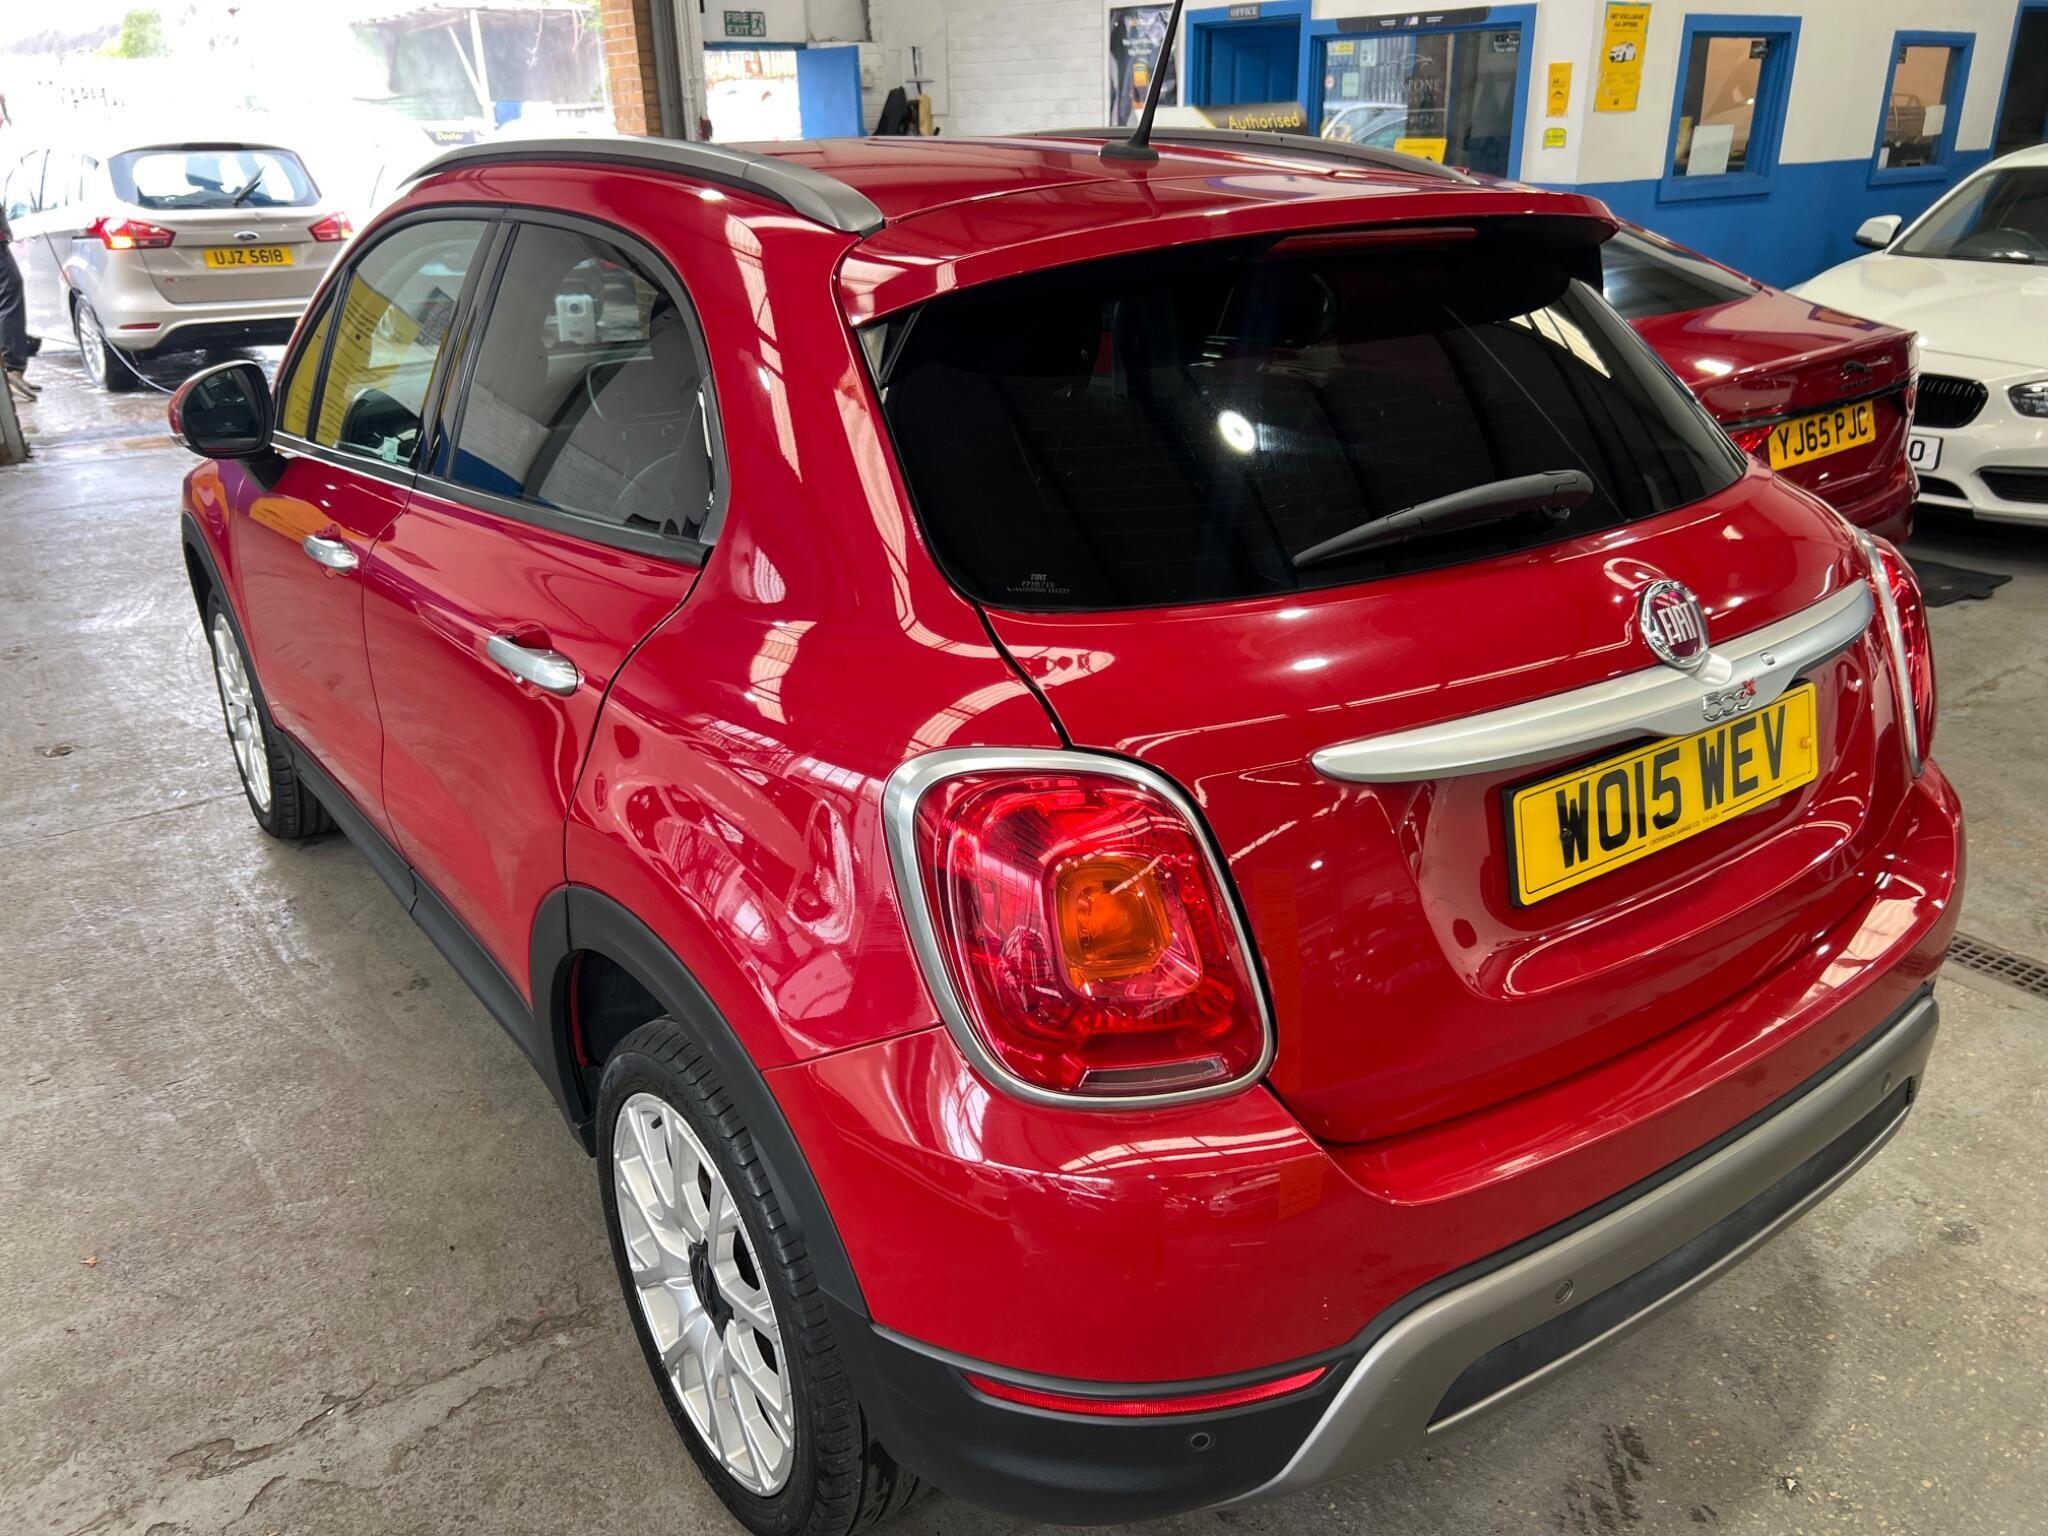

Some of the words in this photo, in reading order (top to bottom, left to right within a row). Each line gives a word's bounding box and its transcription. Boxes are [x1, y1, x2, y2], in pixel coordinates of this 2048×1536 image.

[727, 13, 750, 23] FIRE
[1230, 6, 1258, 17] OFFICE
[727, 25, 750, 35] EXIT
[1228, 111, 1300, 130] Authorised
[213, 250, 246, 265] UJZ
[249, 249, 284, 263] 5618
[1777, 415, 1831, 460] YJ65
[1834, 405, 1869, 444] PJC
[1656, 601, 1698, 646] FIAT
[1555, 747, 1683, 869] WO15
[1697, 704, 1787, 812] WEV
